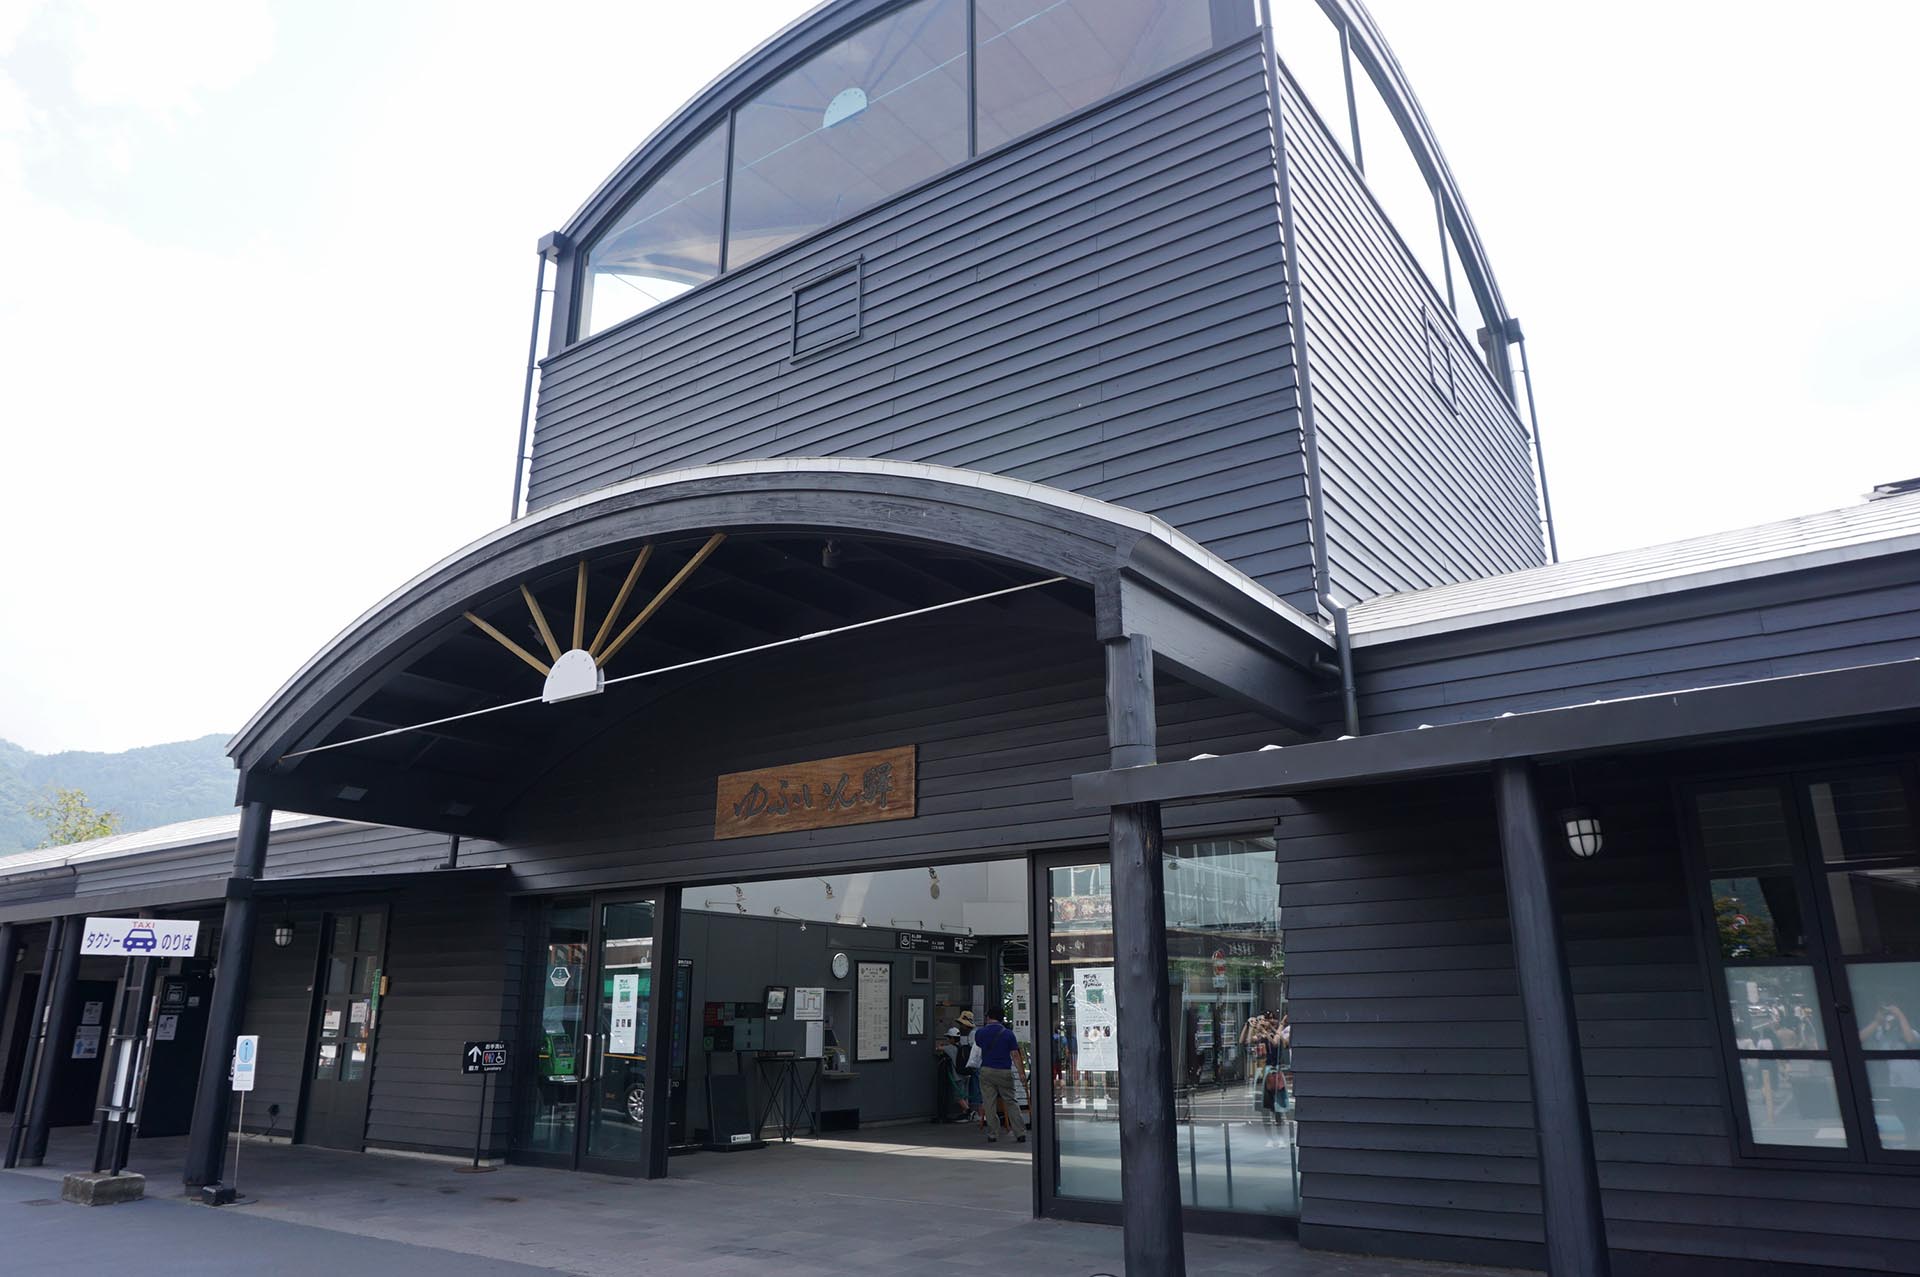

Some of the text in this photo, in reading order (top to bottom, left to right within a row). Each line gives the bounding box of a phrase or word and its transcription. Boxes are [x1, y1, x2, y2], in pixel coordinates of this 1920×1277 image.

[132, 921, 155, 929] TAXI
[87, 932, 193, 951] タクシー のりば
